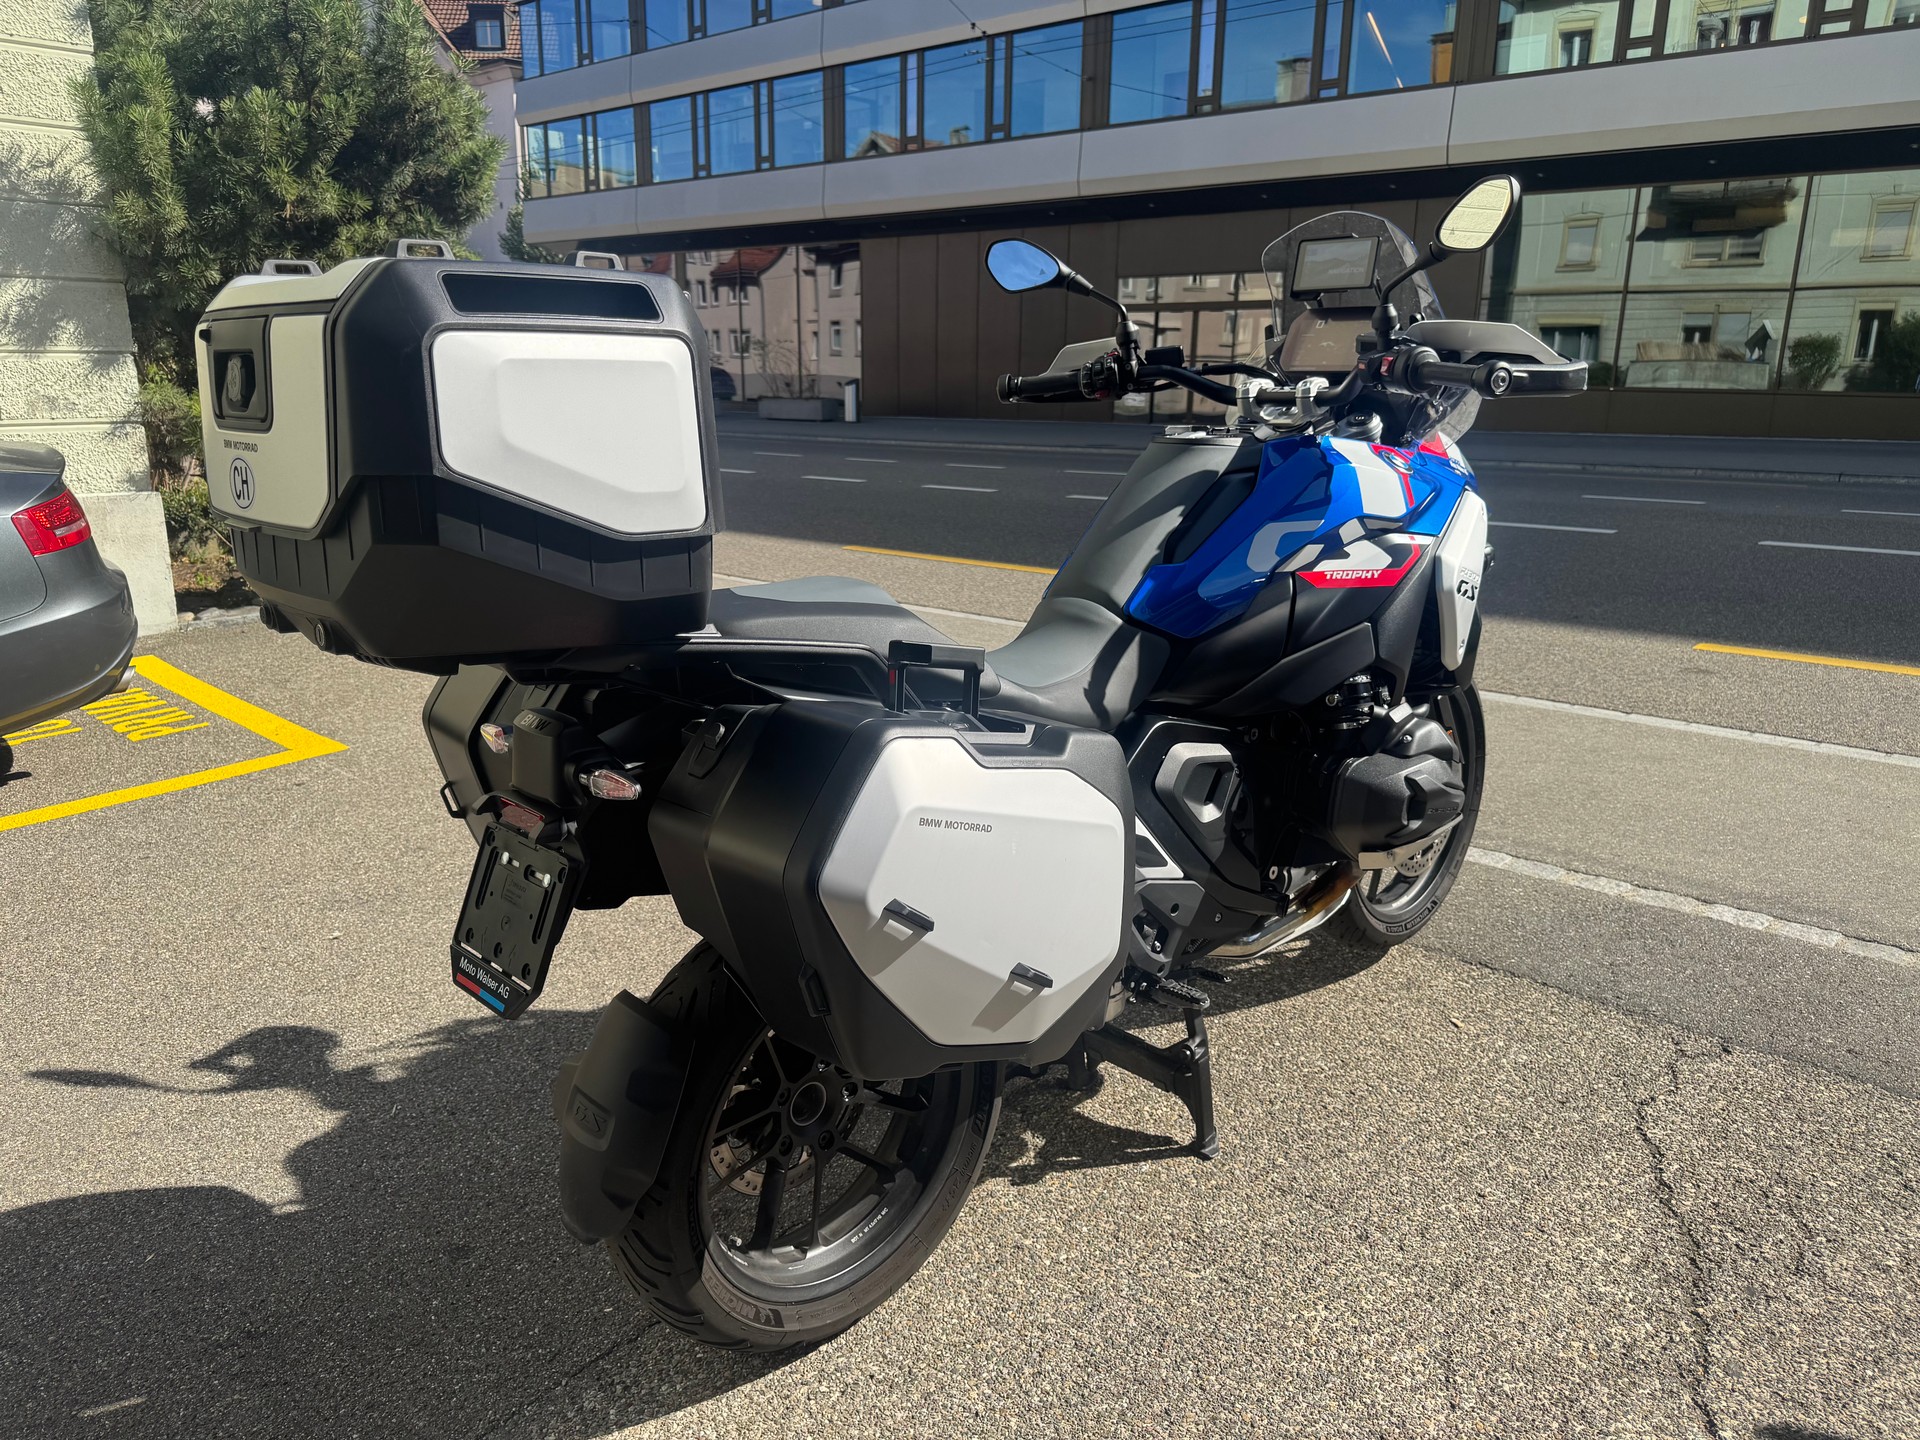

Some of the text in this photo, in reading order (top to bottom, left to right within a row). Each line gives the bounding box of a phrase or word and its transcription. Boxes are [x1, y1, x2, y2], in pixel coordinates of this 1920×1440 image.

[223, 439, 259, 453] BMW MOTORRAD
[233, 465, 250, 501] CH
[1323, 570, 1382, 580] TROPHY
[1456, 579, 1478, 602] GS
[520, 713, 552, 732] BMW
[918, 817, 993, 833] BMW MOTORRAD
[459, 956, 510, 999] Moto Walser AG
